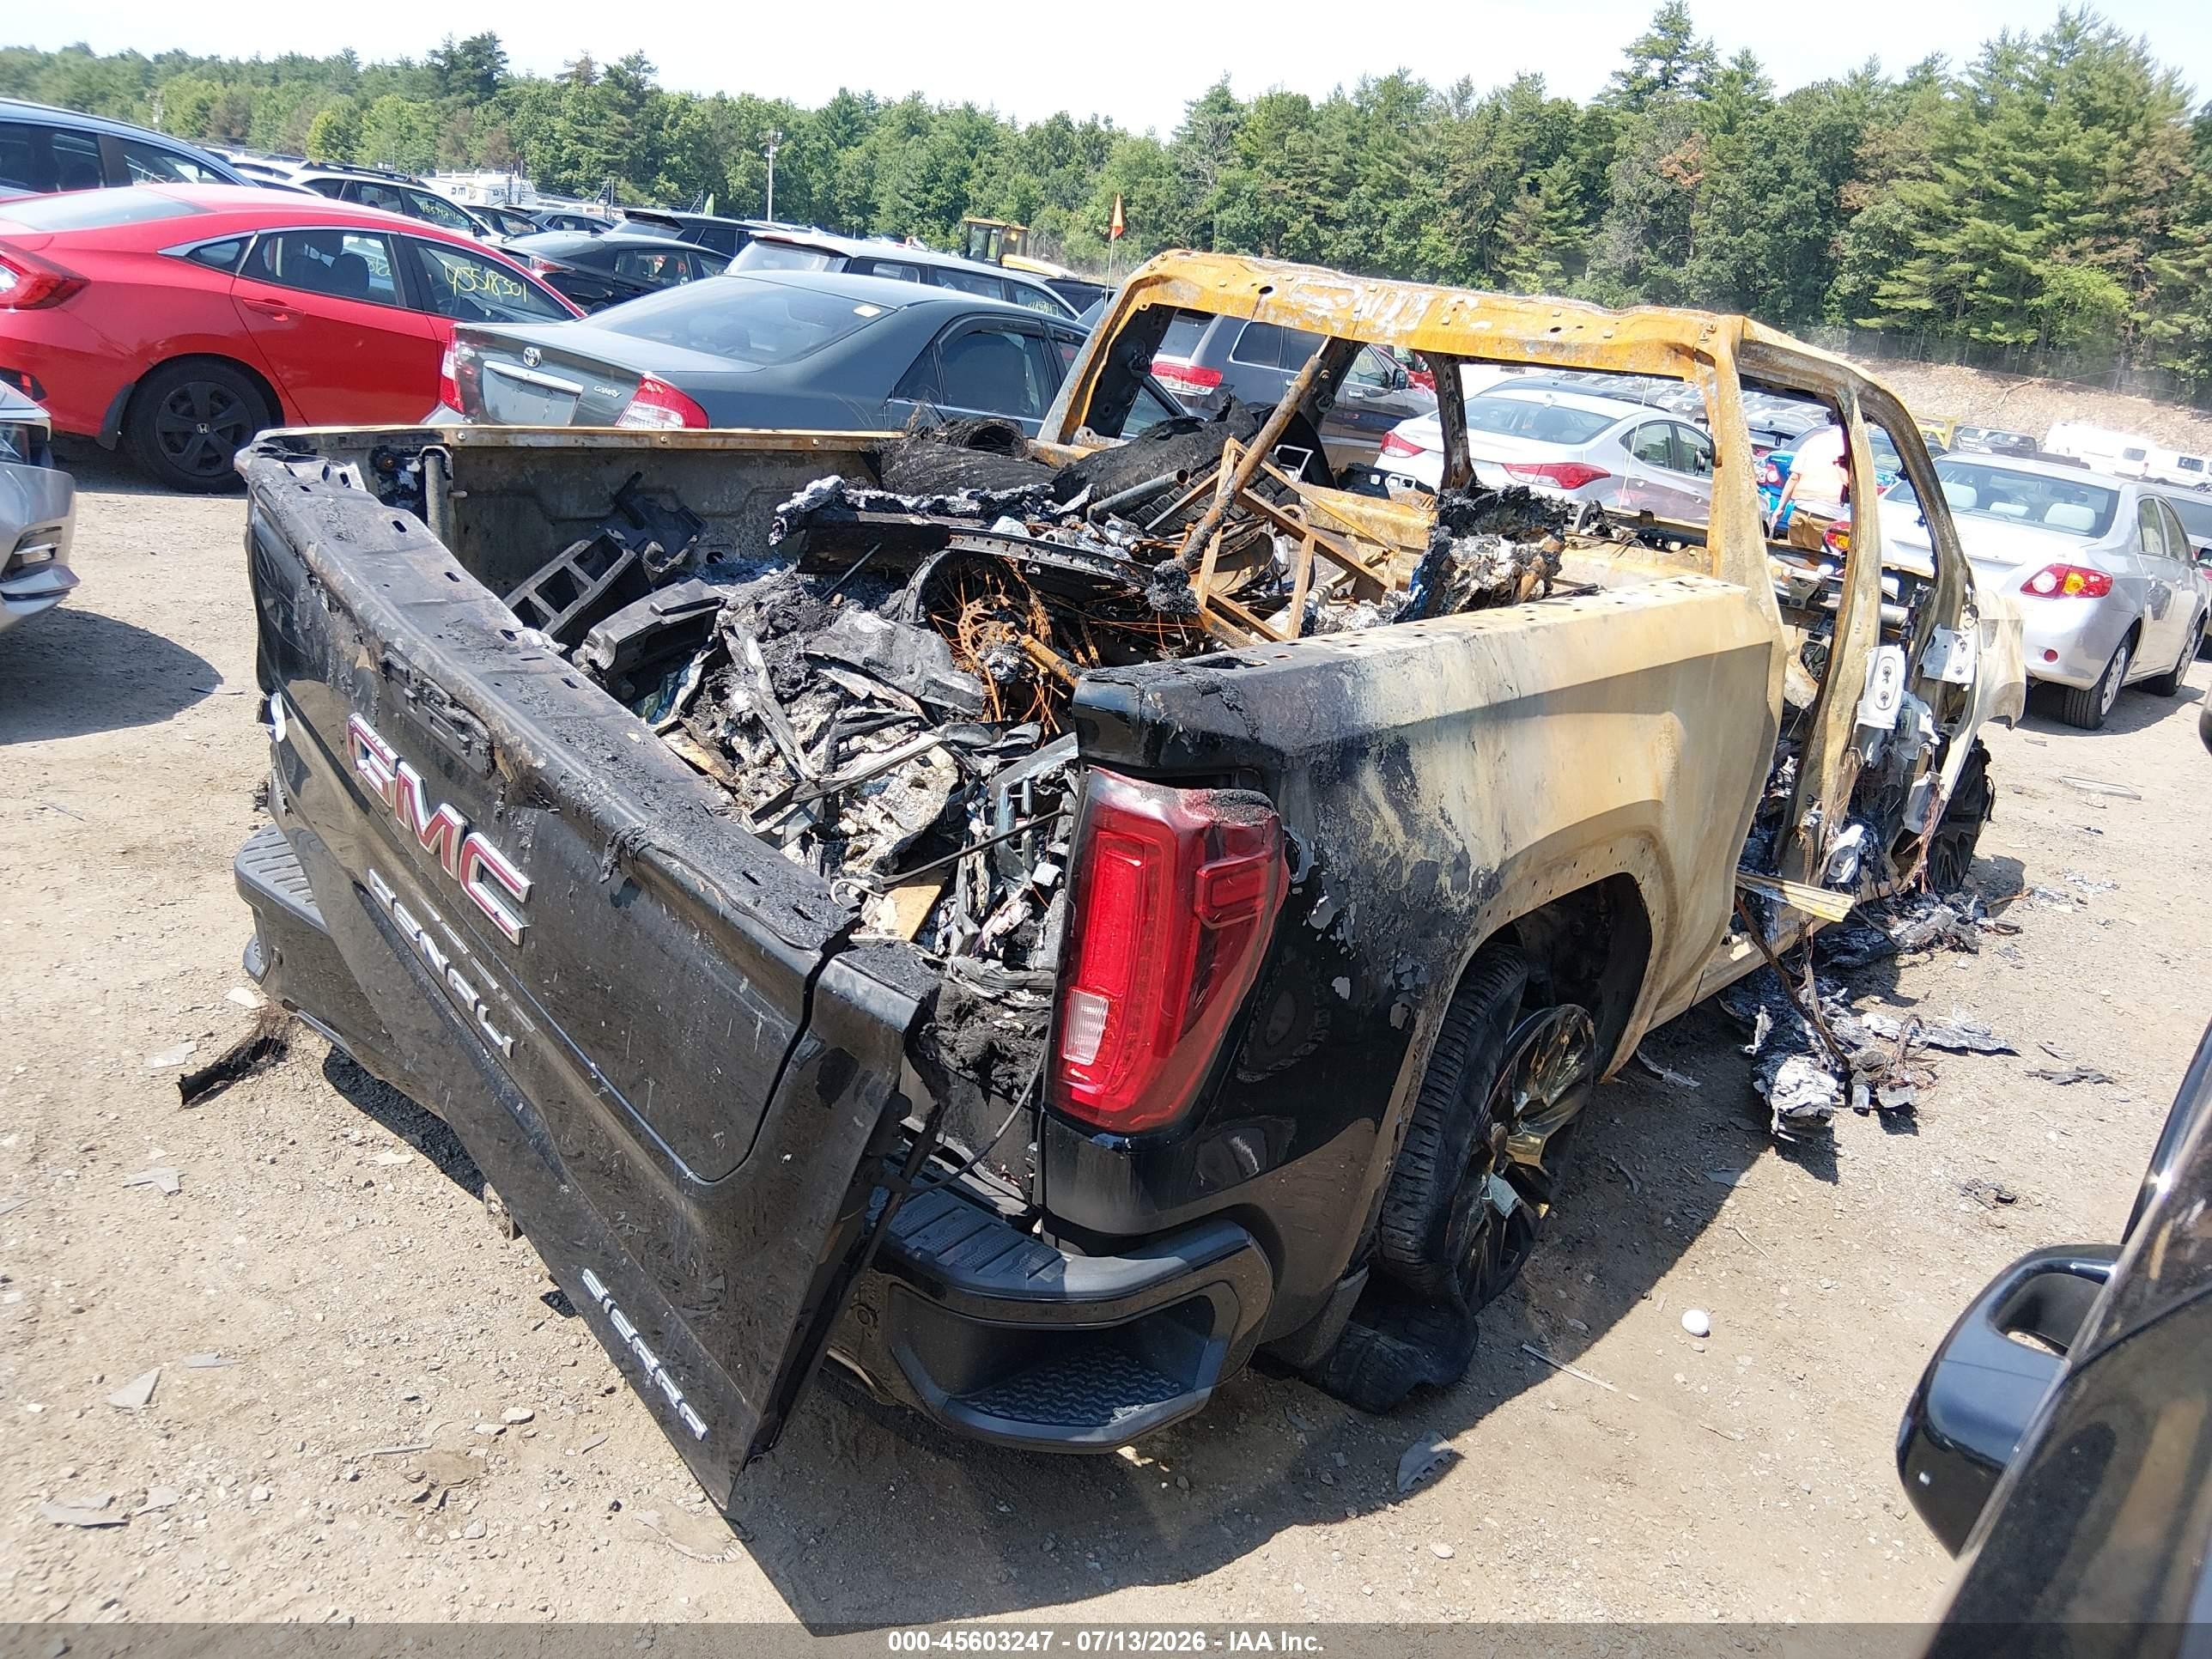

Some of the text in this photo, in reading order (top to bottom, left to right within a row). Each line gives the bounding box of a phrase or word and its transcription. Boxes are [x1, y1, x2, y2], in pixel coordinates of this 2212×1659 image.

[441, 260, 527, 302] 45518301
[347, 712, 536, 946] GMC
[368, 868, 515, 1059] DENALI
[581, 1267, 708, 1441] SIERRA
